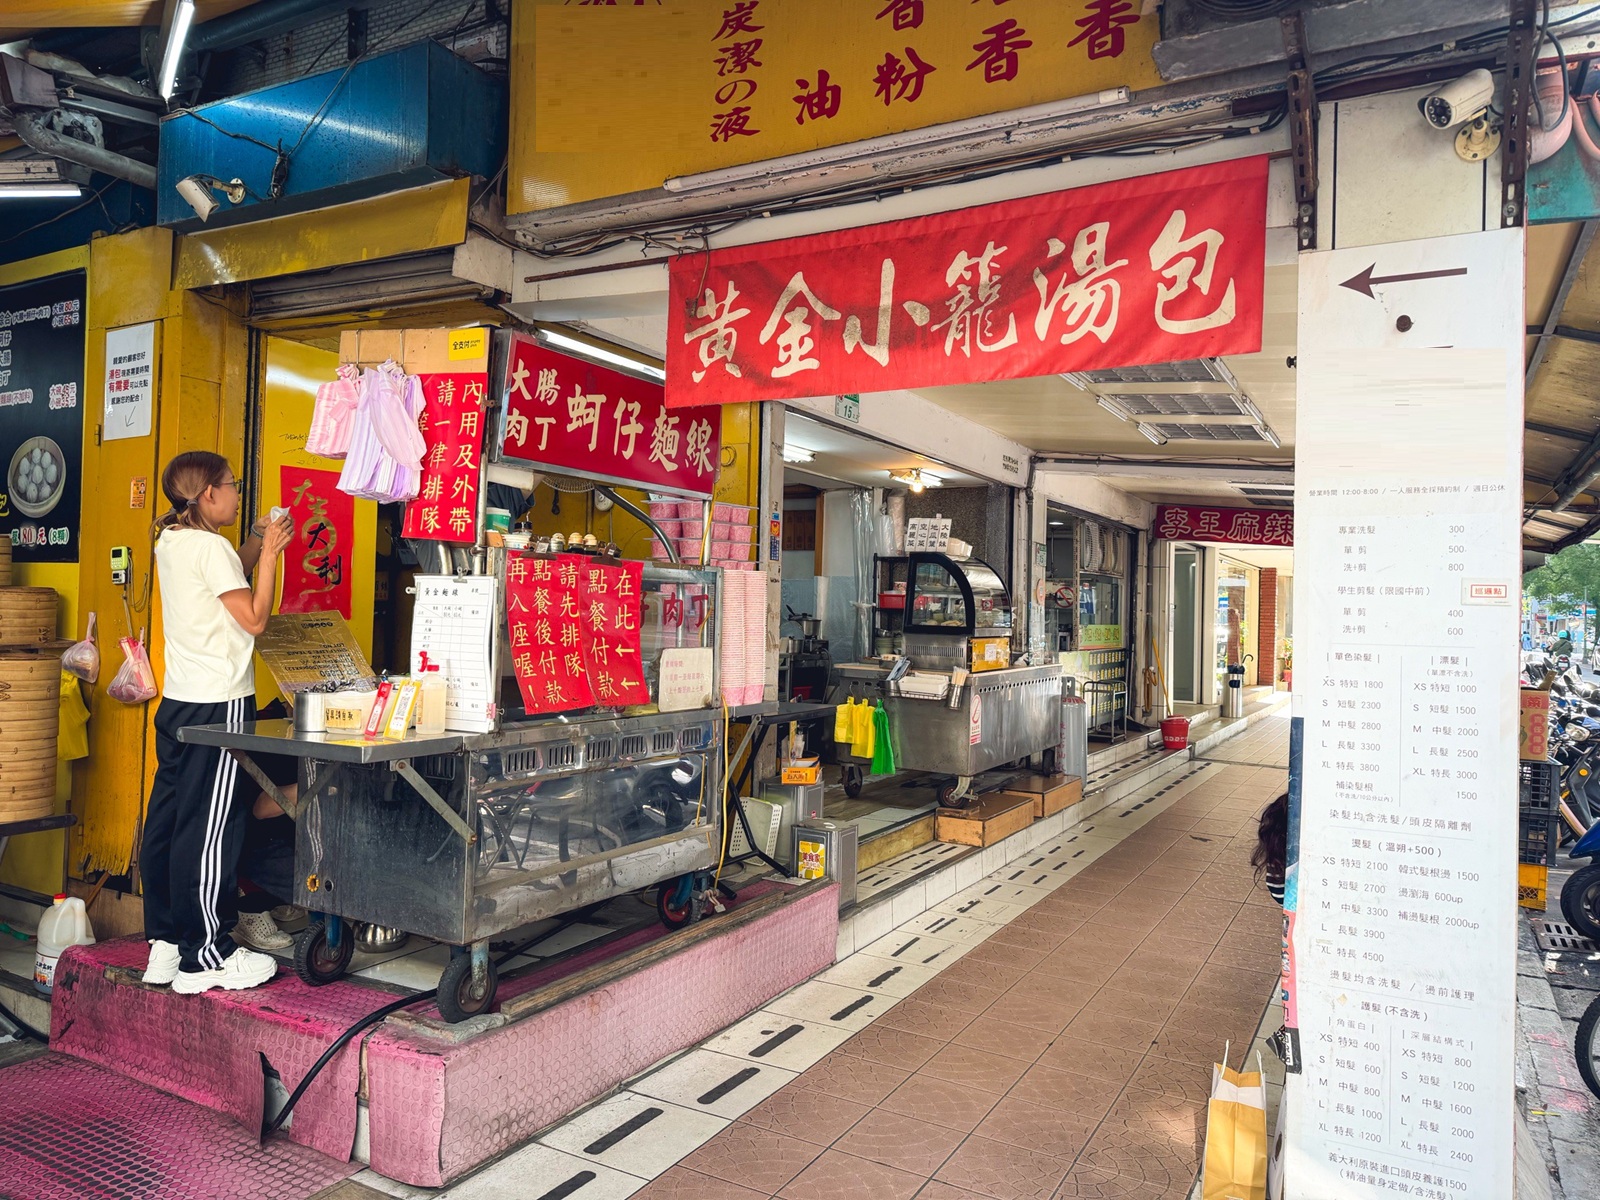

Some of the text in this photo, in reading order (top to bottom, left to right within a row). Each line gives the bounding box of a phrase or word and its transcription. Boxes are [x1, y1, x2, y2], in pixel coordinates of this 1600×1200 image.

[793, 69, 841, 125] 油
[685, 209, 1235, 383] 黃金小籠湯包
[510, 358, 560, 405] 大腸
[504, 407, 556, 451] 肉丁
[566, 384, 714, 478] 蚵仔麵線
[420, 381, 456, 535] 請一律排隊
[448, 381, 483, 536] 內用及外帶
[1160, 507, 1294, 545] 李王麻辣
[1448, 525, 1465, 533] 300
[1448, 545, 1465, 553] 500
[1448, 563, 1464, 572] 800
[613, 571, 635, 631] 在此
[1447, 609, 1464, 618] 400
[559, 563, 586, 678] 請先排隊
[508, 558, 540, 709] 再入座喔!
[532, 559, 568, 706] 點餐後付款
[587, 569, 620, 699] 點餐付款
[1447, 627, 1464, 636] 600
[1364, 681, 1384, 689] 1800
[1456, 684, 1477, 693] 1000
[1361, 701, 1381, 710] 2300
[1455, 706, 1476, 715] 1500
[1361, 722, 1382, 731] 2800
[1457, 728, 1479, 737] 2000
[1361, 743, 1381, 751] 3300
[1457, 749, 1479, 758] 2500
[1359, 763, 1380, 772] 3800
[1456, 771, 1478, 780] 3000
[1456, 792, 1478, 800] 1500
[1322, 856, 1336, 865] XS
[1366, 861, 1389, 872] 2100
[1457, 871, 1480, 882] 1500
[1322, 878, 1328, 887] S
[1364, 883, 1386, 894] 2700
[1434, 892, 1464, 904] 600up
[1321, 901, 1331, 910] M
[1366, 906, 1389, 917] 3300
[1445, 916, 1480, 930] 2000up
[1321, 923, 1327, 932] L
[1363, 929, 1385, 940] 3900
[1321, 945, 1331, 955] XL
[1362, 951, 1385, 962] 4500
[1363, 1041, 1380, 1052] 400
[1454, 1057, 1472, 1068] 800
[1364, 1064, 1381, 1075] 600
[1363, 1086, 1381, 1097] 800
[1452, 1080, 1475, 1093] 1200
[1361, 1108, 1383, 1121] 1000
[1450, 1103, 1473, 1115] 1600
[1360, 1131, 1382, 1143] 1200
[1451, 1127, 1475, 1140] 2000
[1450, 1150, 1474, 1163] 2400
